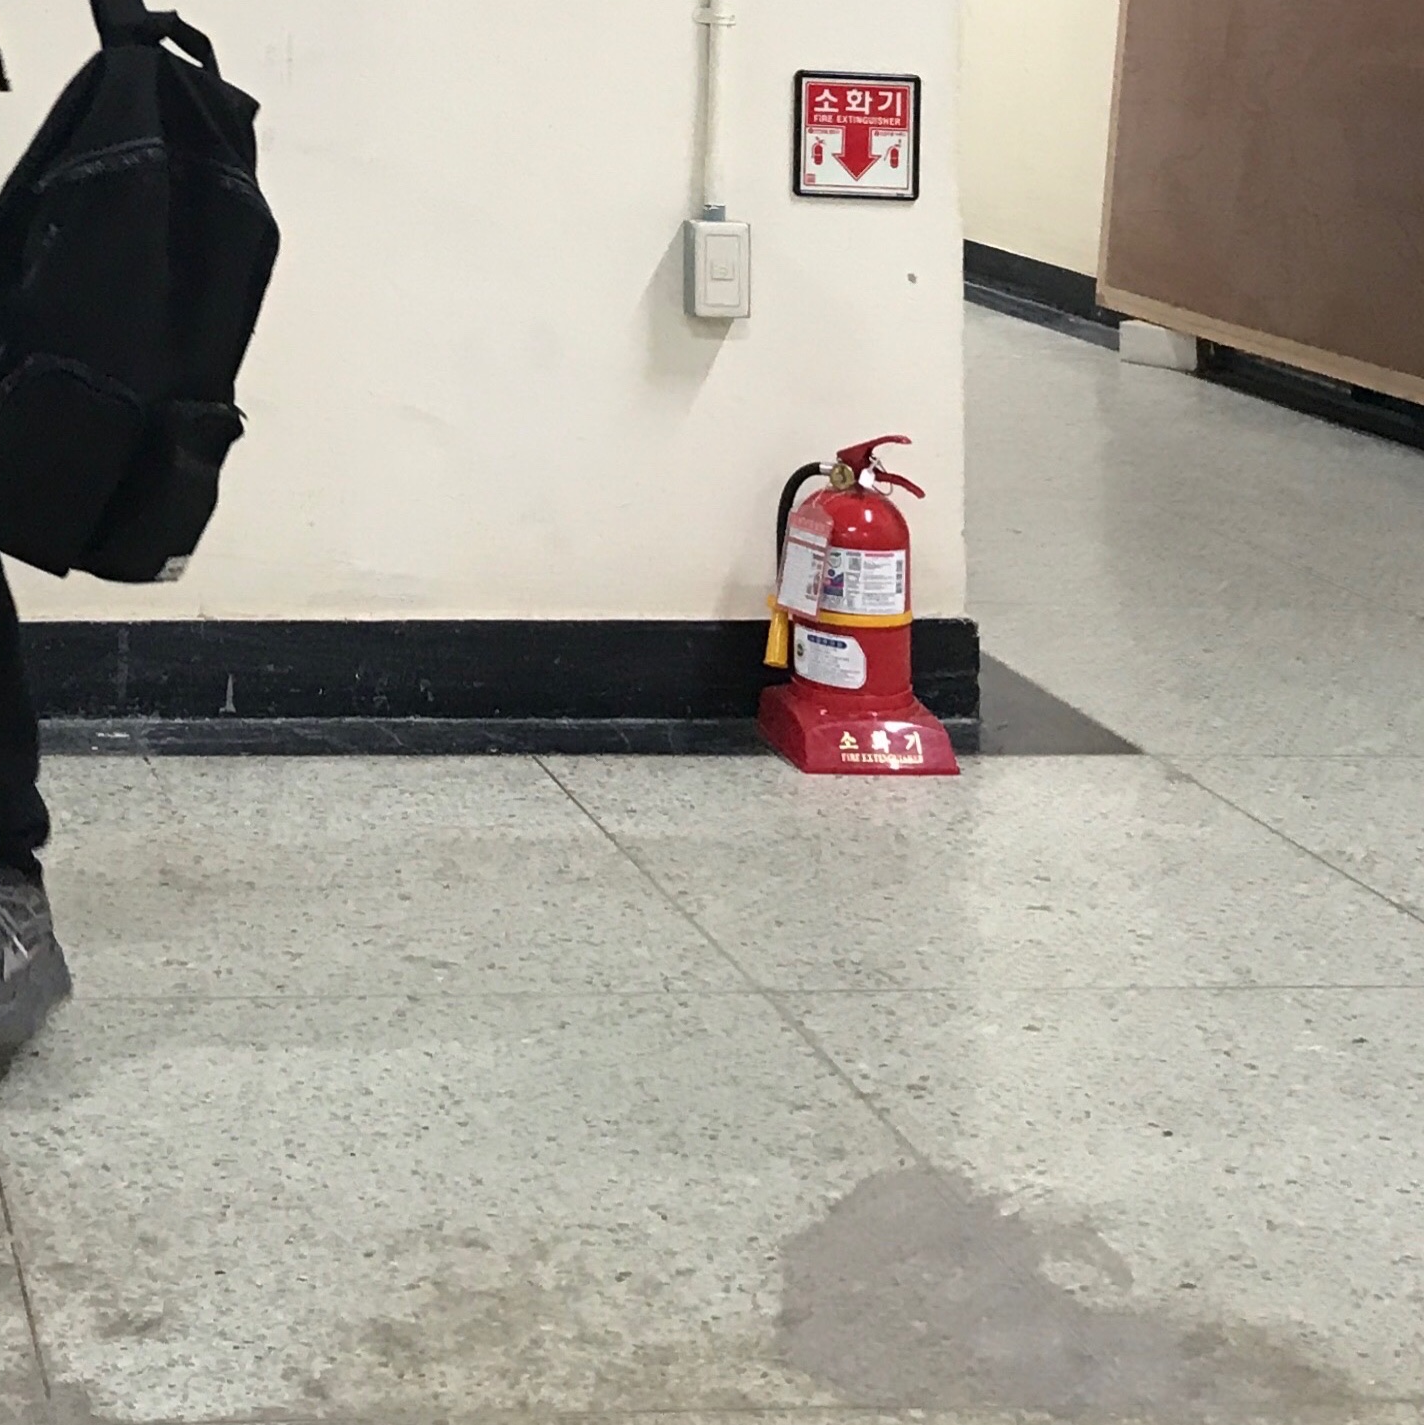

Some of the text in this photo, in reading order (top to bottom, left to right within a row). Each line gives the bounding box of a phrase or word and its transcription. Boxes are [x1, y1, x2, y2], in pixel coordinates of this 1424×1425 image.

[813, 88, 902, 117] 소화기
[813, 114, 901, 126] FIRE EXTINGUISHER
[839, 730, 923, 754] 소화기
